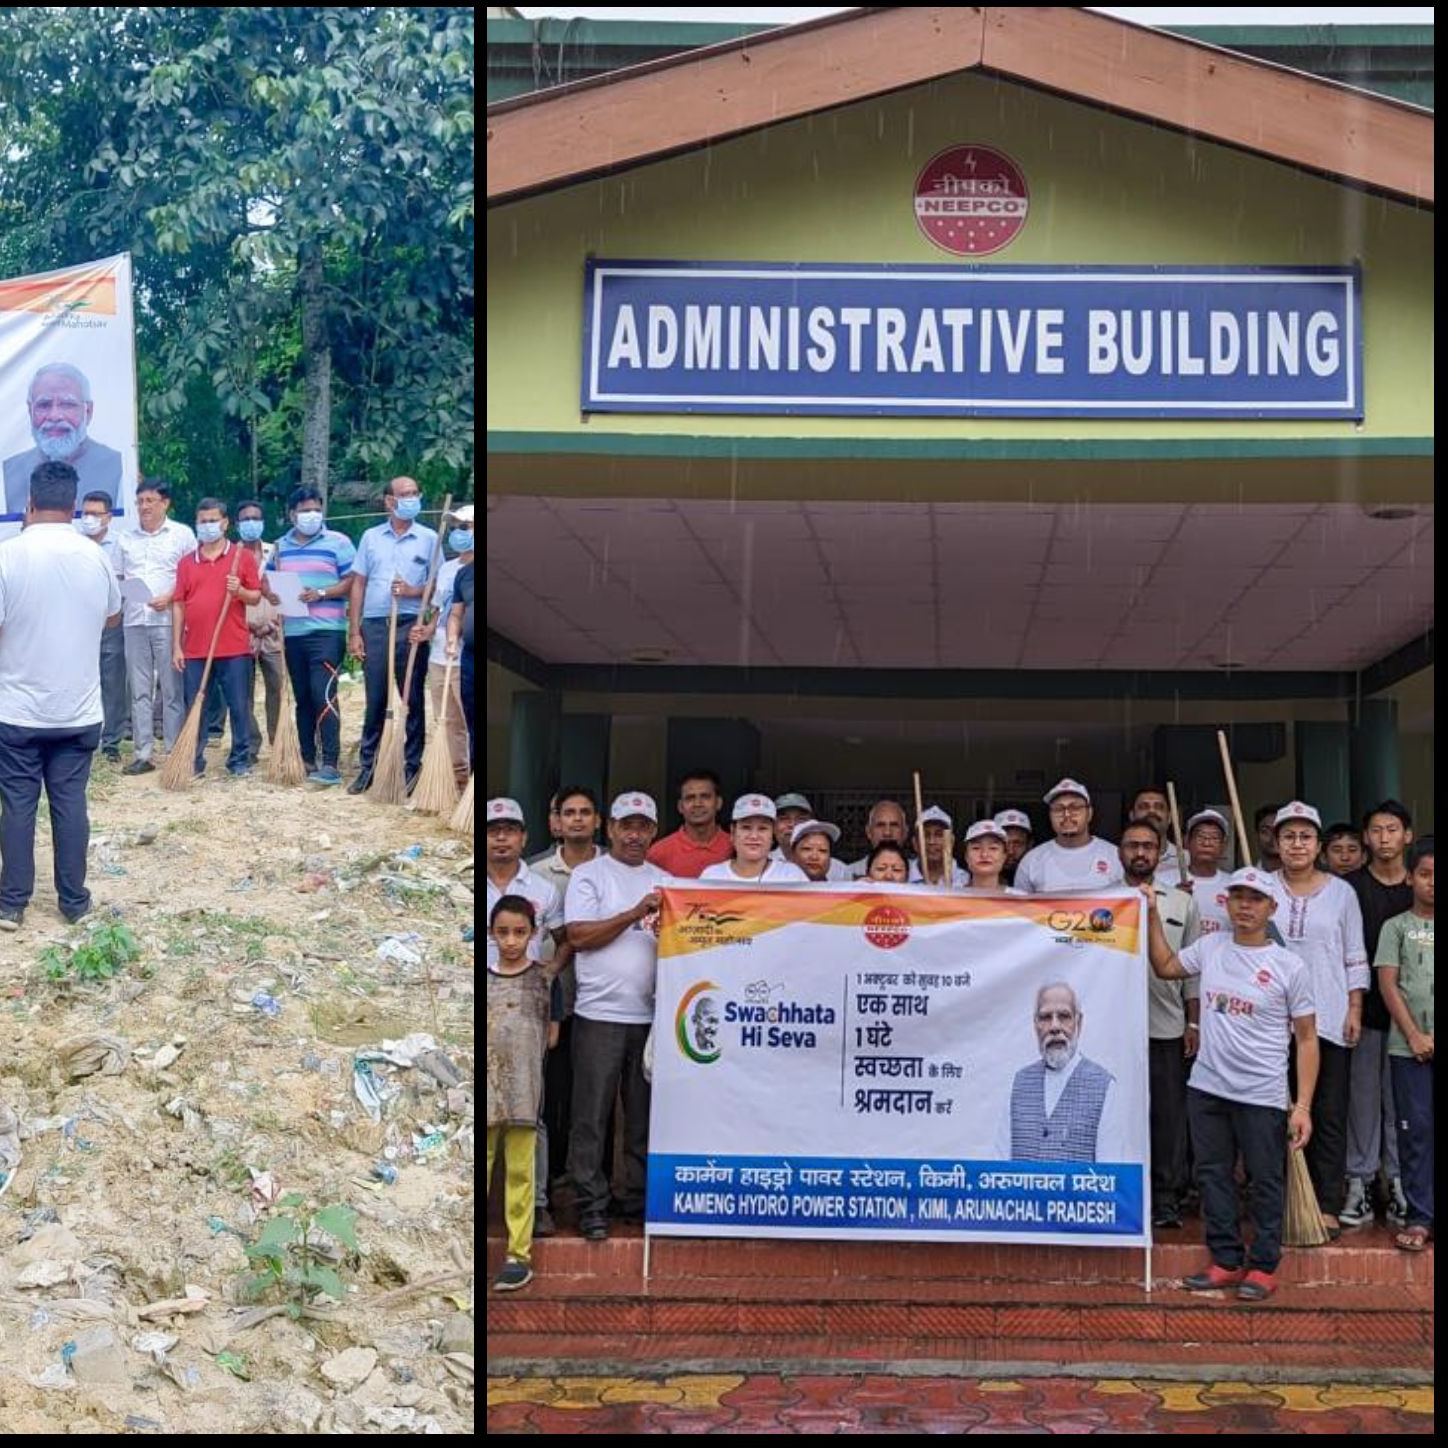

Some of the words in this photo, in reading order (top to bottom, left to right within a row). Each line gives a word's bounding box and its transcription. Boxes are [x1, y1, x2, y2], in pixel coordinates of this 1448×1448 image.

[933, 173, 1011, 194] नीपको
[923, 200, 1020, 213] NEEPCO
[607, 304, 1065, 375] ADMINISTRATIVE
[1087, 309, 1341, 376] BUILDING
[903, 970, 916, 986] को
[942, 976, 952, 986] 10
[724, 1001, 836, 1025] Swachhata
[856, 993, 888, 1015] एक
[891, 994, 929, 1016] साथ
[741, 1026, 761, 1047] Hi
[767, 1027, 817, 1048] Seva
[855, 1027, 863, 1048] 1
[866, 1021, 894, 1048] घंटे
[854, 1056, 923, 1078] स्वच्छता
[928, 1065, 939, 1078] के
[854, 1089, 934, 1115] श्रमदान
[674, 1159, 733, 1185] कामेंग
[739, 1161, 793, 1191] हाइड्रो
[800, 1168, 843, 1186] पावर
[849, 1163, 912, 1190] स्टेशन,
[919, 1163, 973, 1191] किमी,
[978, 1172, 1066, 1192] अरुणाचल
[1071, 1167, 1116, 1194] प्रदेश
[673, 1191, 736, 1215] KAMENG
[738, 1194, 789, 1216] HYDRO
[792, 1196, 845, 1218] POWER
[848, 1196, 907, 1219] STATION
[918, 1198, 952, 1223] KIMI,
[954, 1198, 1044, 1222] ARUNACHAL
[1047, 1201, 1116, 1224] PRADESH
